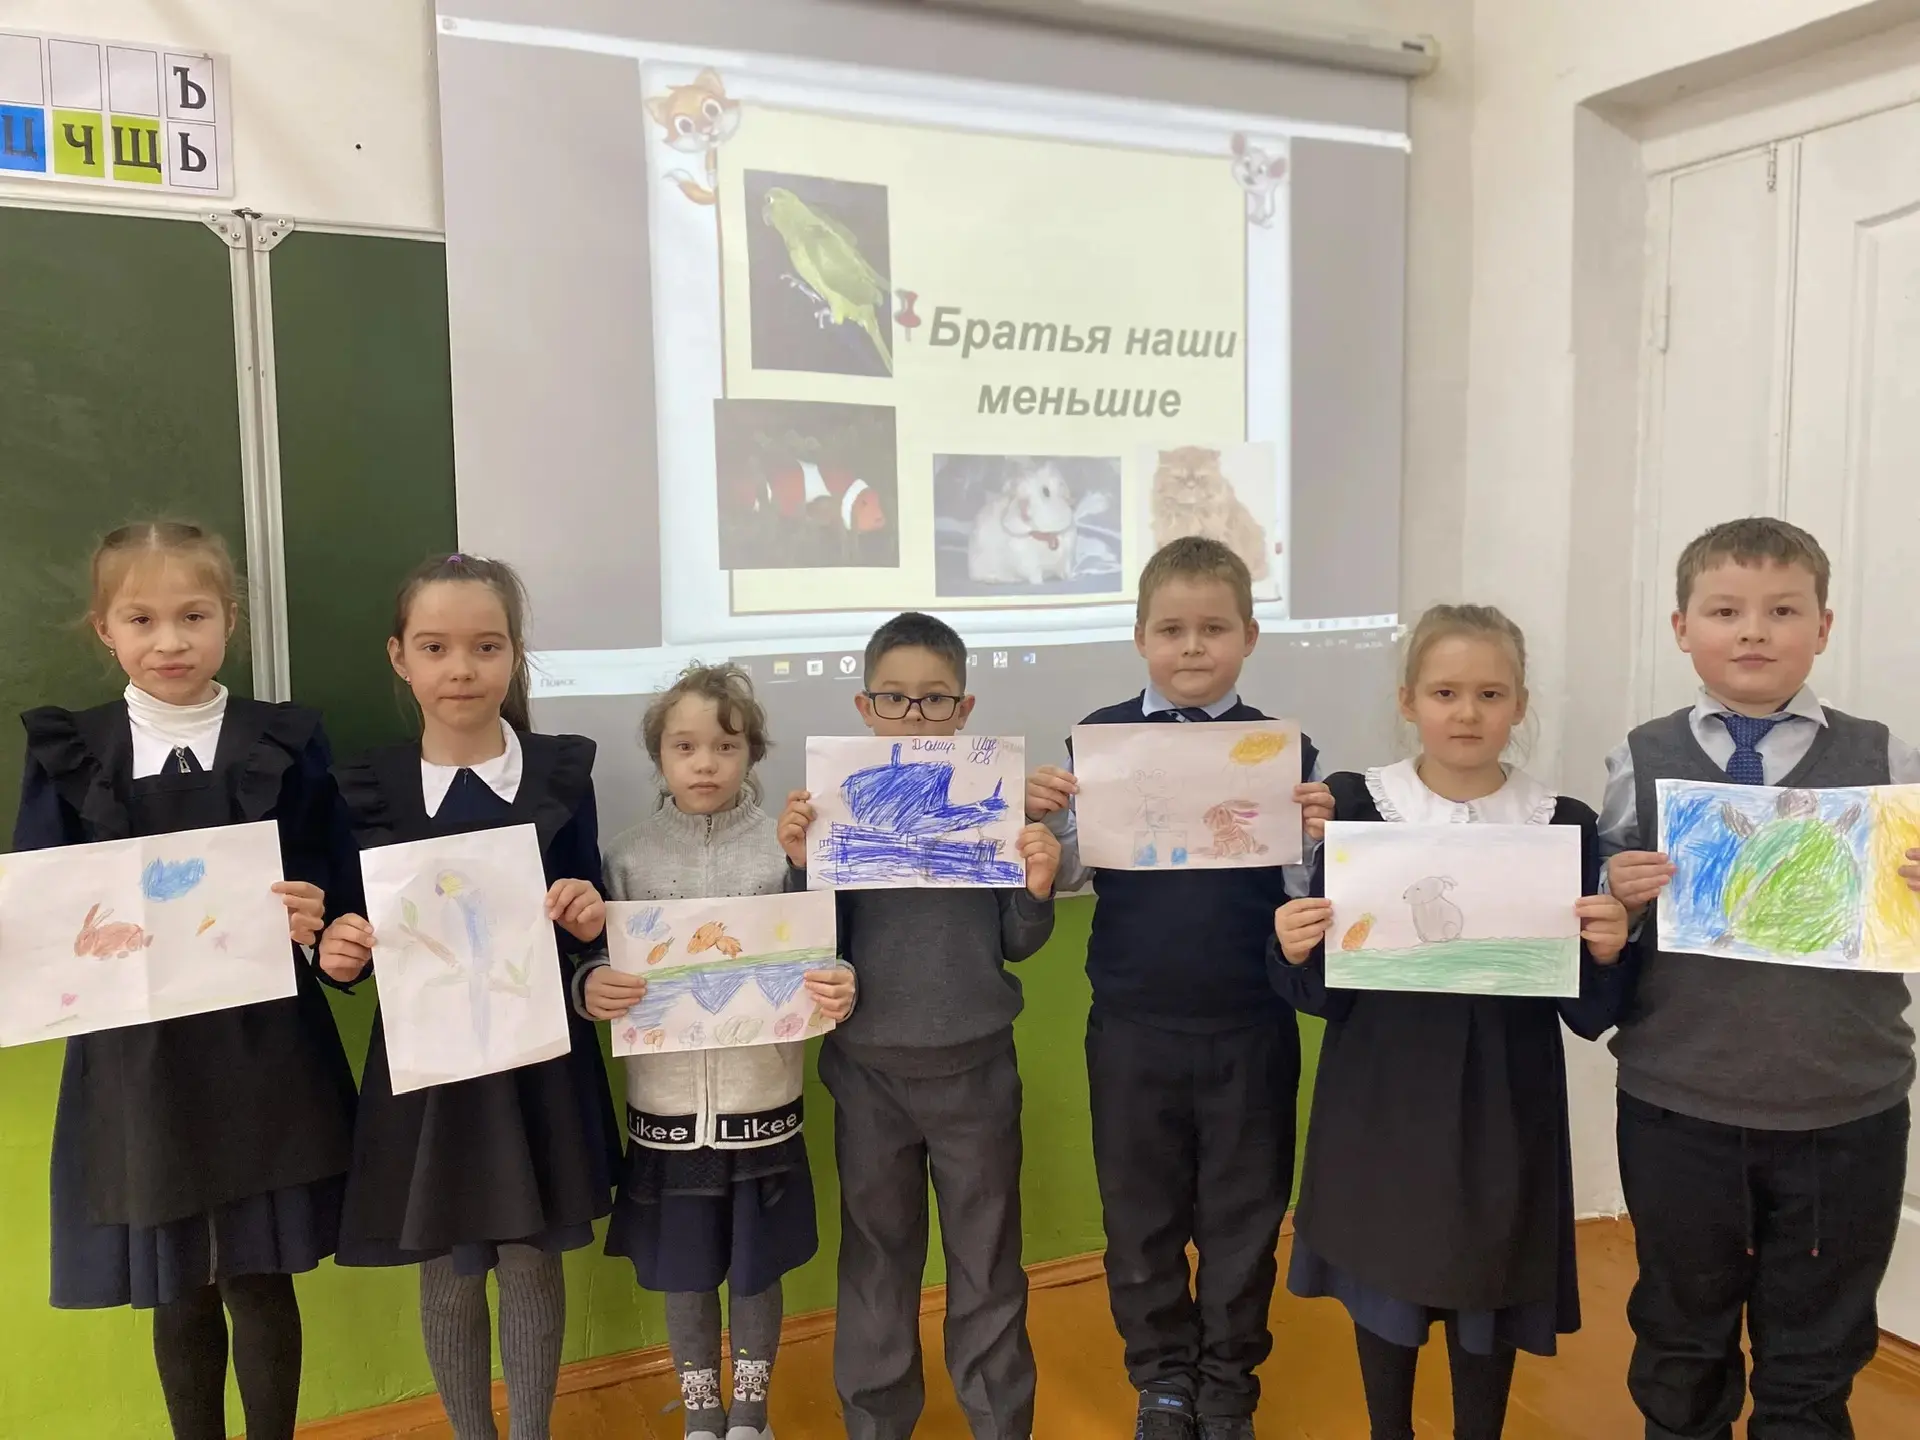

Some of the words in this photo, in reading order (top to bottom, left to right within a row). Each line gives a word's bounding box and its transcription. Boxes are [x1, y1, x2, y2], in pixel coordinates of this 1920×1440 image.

[173, 66, 207, 110] Ъ
[1, 113, 39, 162] Ц
[62, 123, 96, 165] Ч
[111, 125, 163, 173] Щ
[178, 132, 208, 173] Ь
[928, 305, 1112, 359] Братья
[1124, 325, 1238, 359] наши
[976, 383, 1182, 418] меньшие
[628, 1111, 690, 1142] Likee
[720, 1111, 798, 1140] Likee
